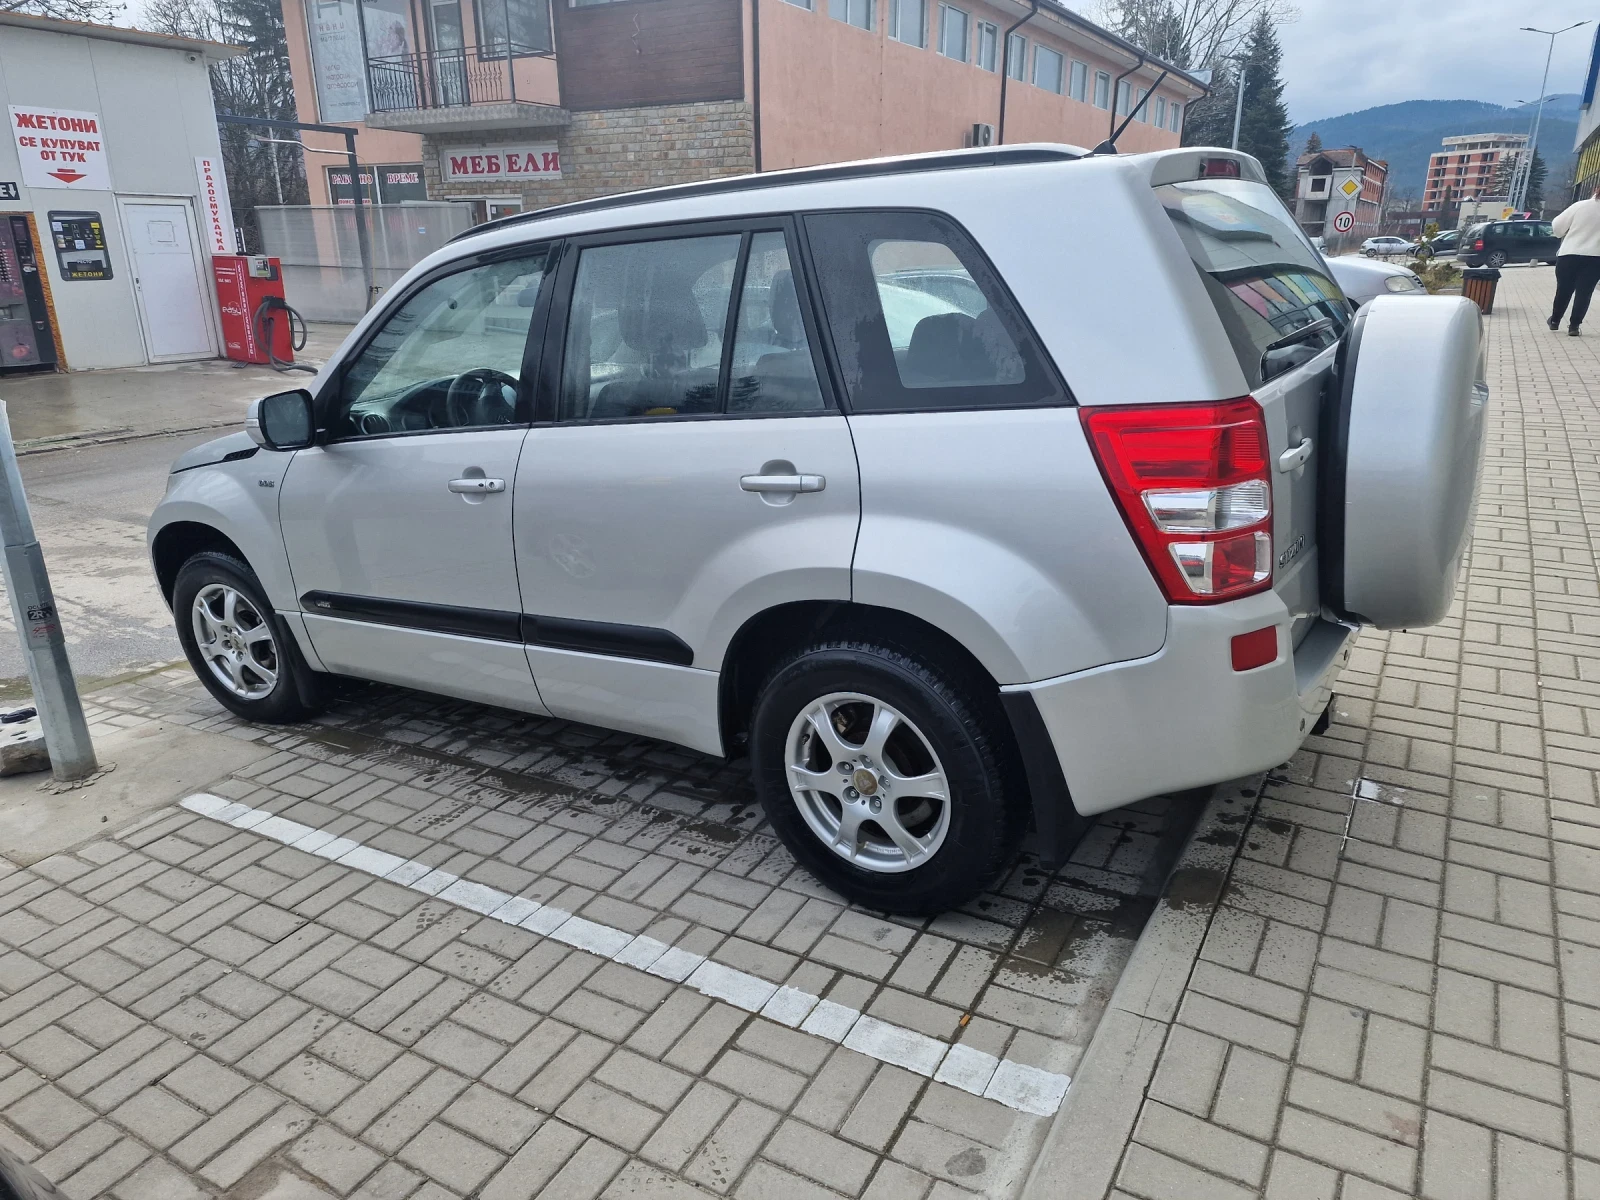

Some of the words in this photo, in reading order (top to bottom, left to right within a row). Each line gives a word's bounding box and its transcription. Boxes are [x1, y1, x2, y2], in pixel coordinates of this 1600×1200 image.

[14, 113, 98, 133] ЖЕТОНИ
[19, 136, 37, 147] СЕ
[40, 138, 100, 151] КУПУВАТ
[40, 150, 57, 161] ОТ
[60, 151, 86, 162] ТУК
[450, 152, 560, 175] МЕБЕЛИ
[387, 172, 419, 184] ВРЕМЕ
[203, 160, 225, 251] ПРАХОСМУКАЧКА
[1338, 217, 1350, 228] 10
